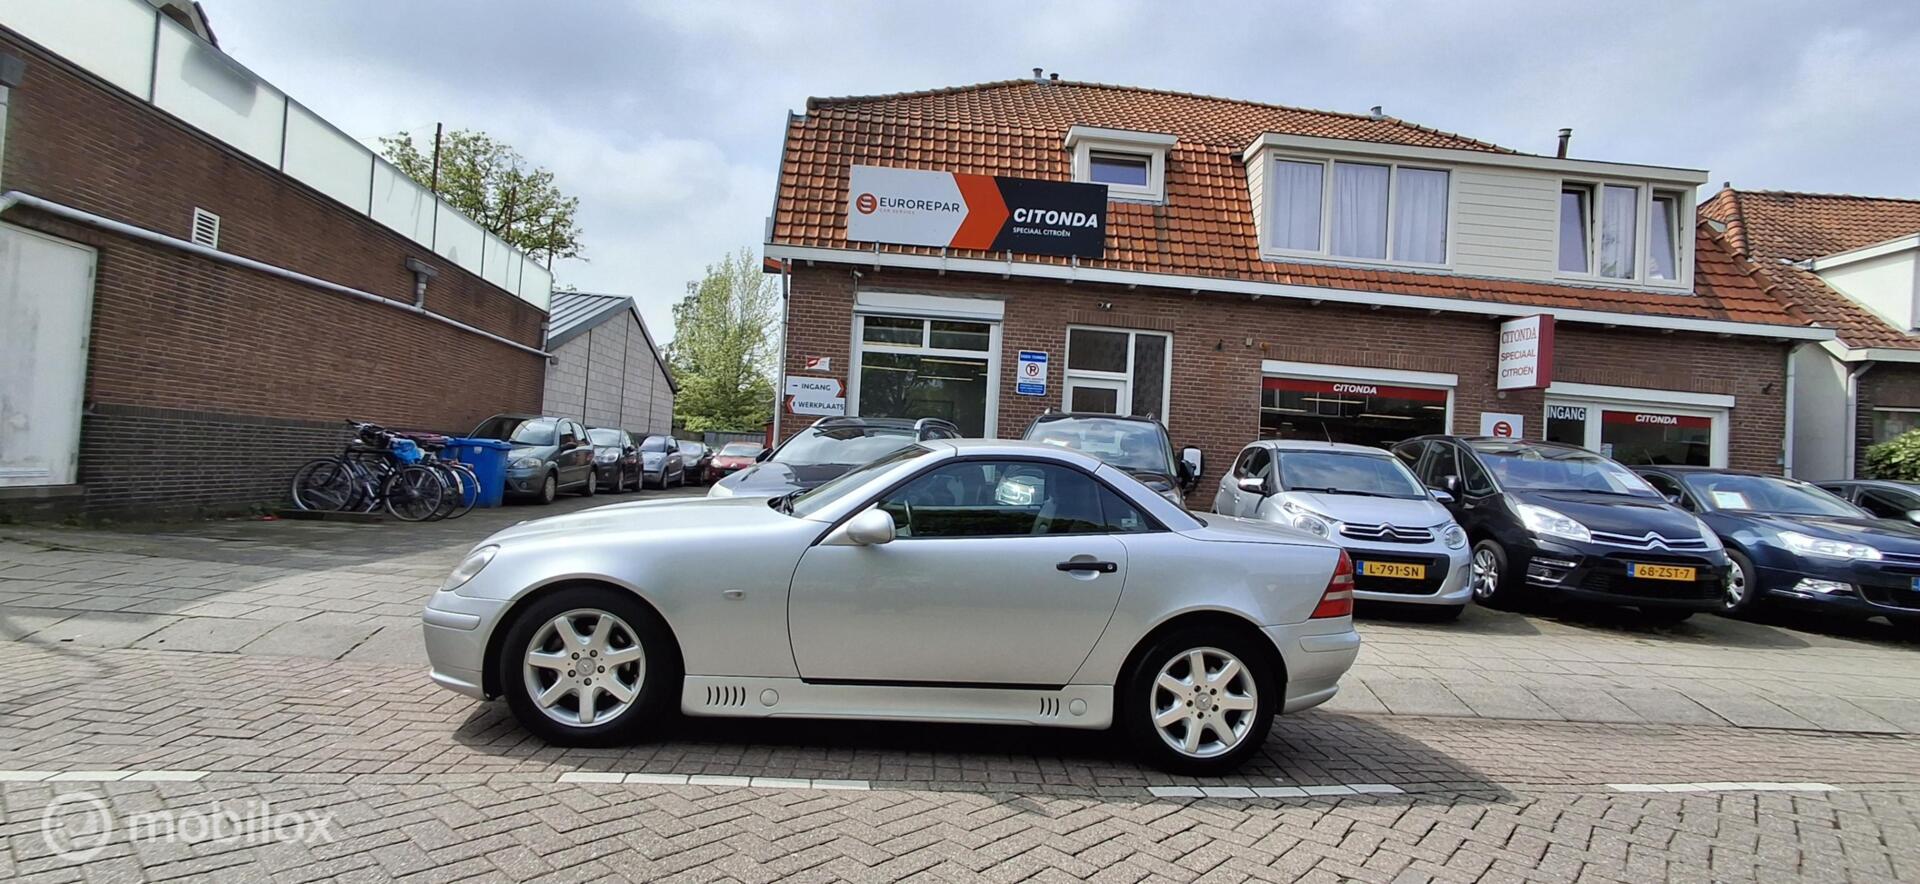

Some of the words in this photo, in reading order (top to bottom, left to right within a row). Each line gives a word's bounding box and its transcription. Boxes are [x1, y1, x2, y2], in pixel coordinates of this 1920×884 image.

[879, 197, 960, 213] EUROREPAR
[1013, 208, 1098, 228] CITONDA
[1012, 227, 1042, 235] SPECIAAL
[1501, 327, 1537, 345] CITONDA
[1500, 349, 1537, 361] SPECIAAL
[801, 383, 831, 391] INGANG
[1333, 383, 1377, 394] CITONDA
[798, 401, 844, 410] WERKPLAATS
[1546, 406, 1585, 420] INGANG
[1635, 414, 1678, 424] CITONDA
[1369, 563, 1419, 577] L-791-SN
[1639, 566, 1690, 579] 68-ZST-7
